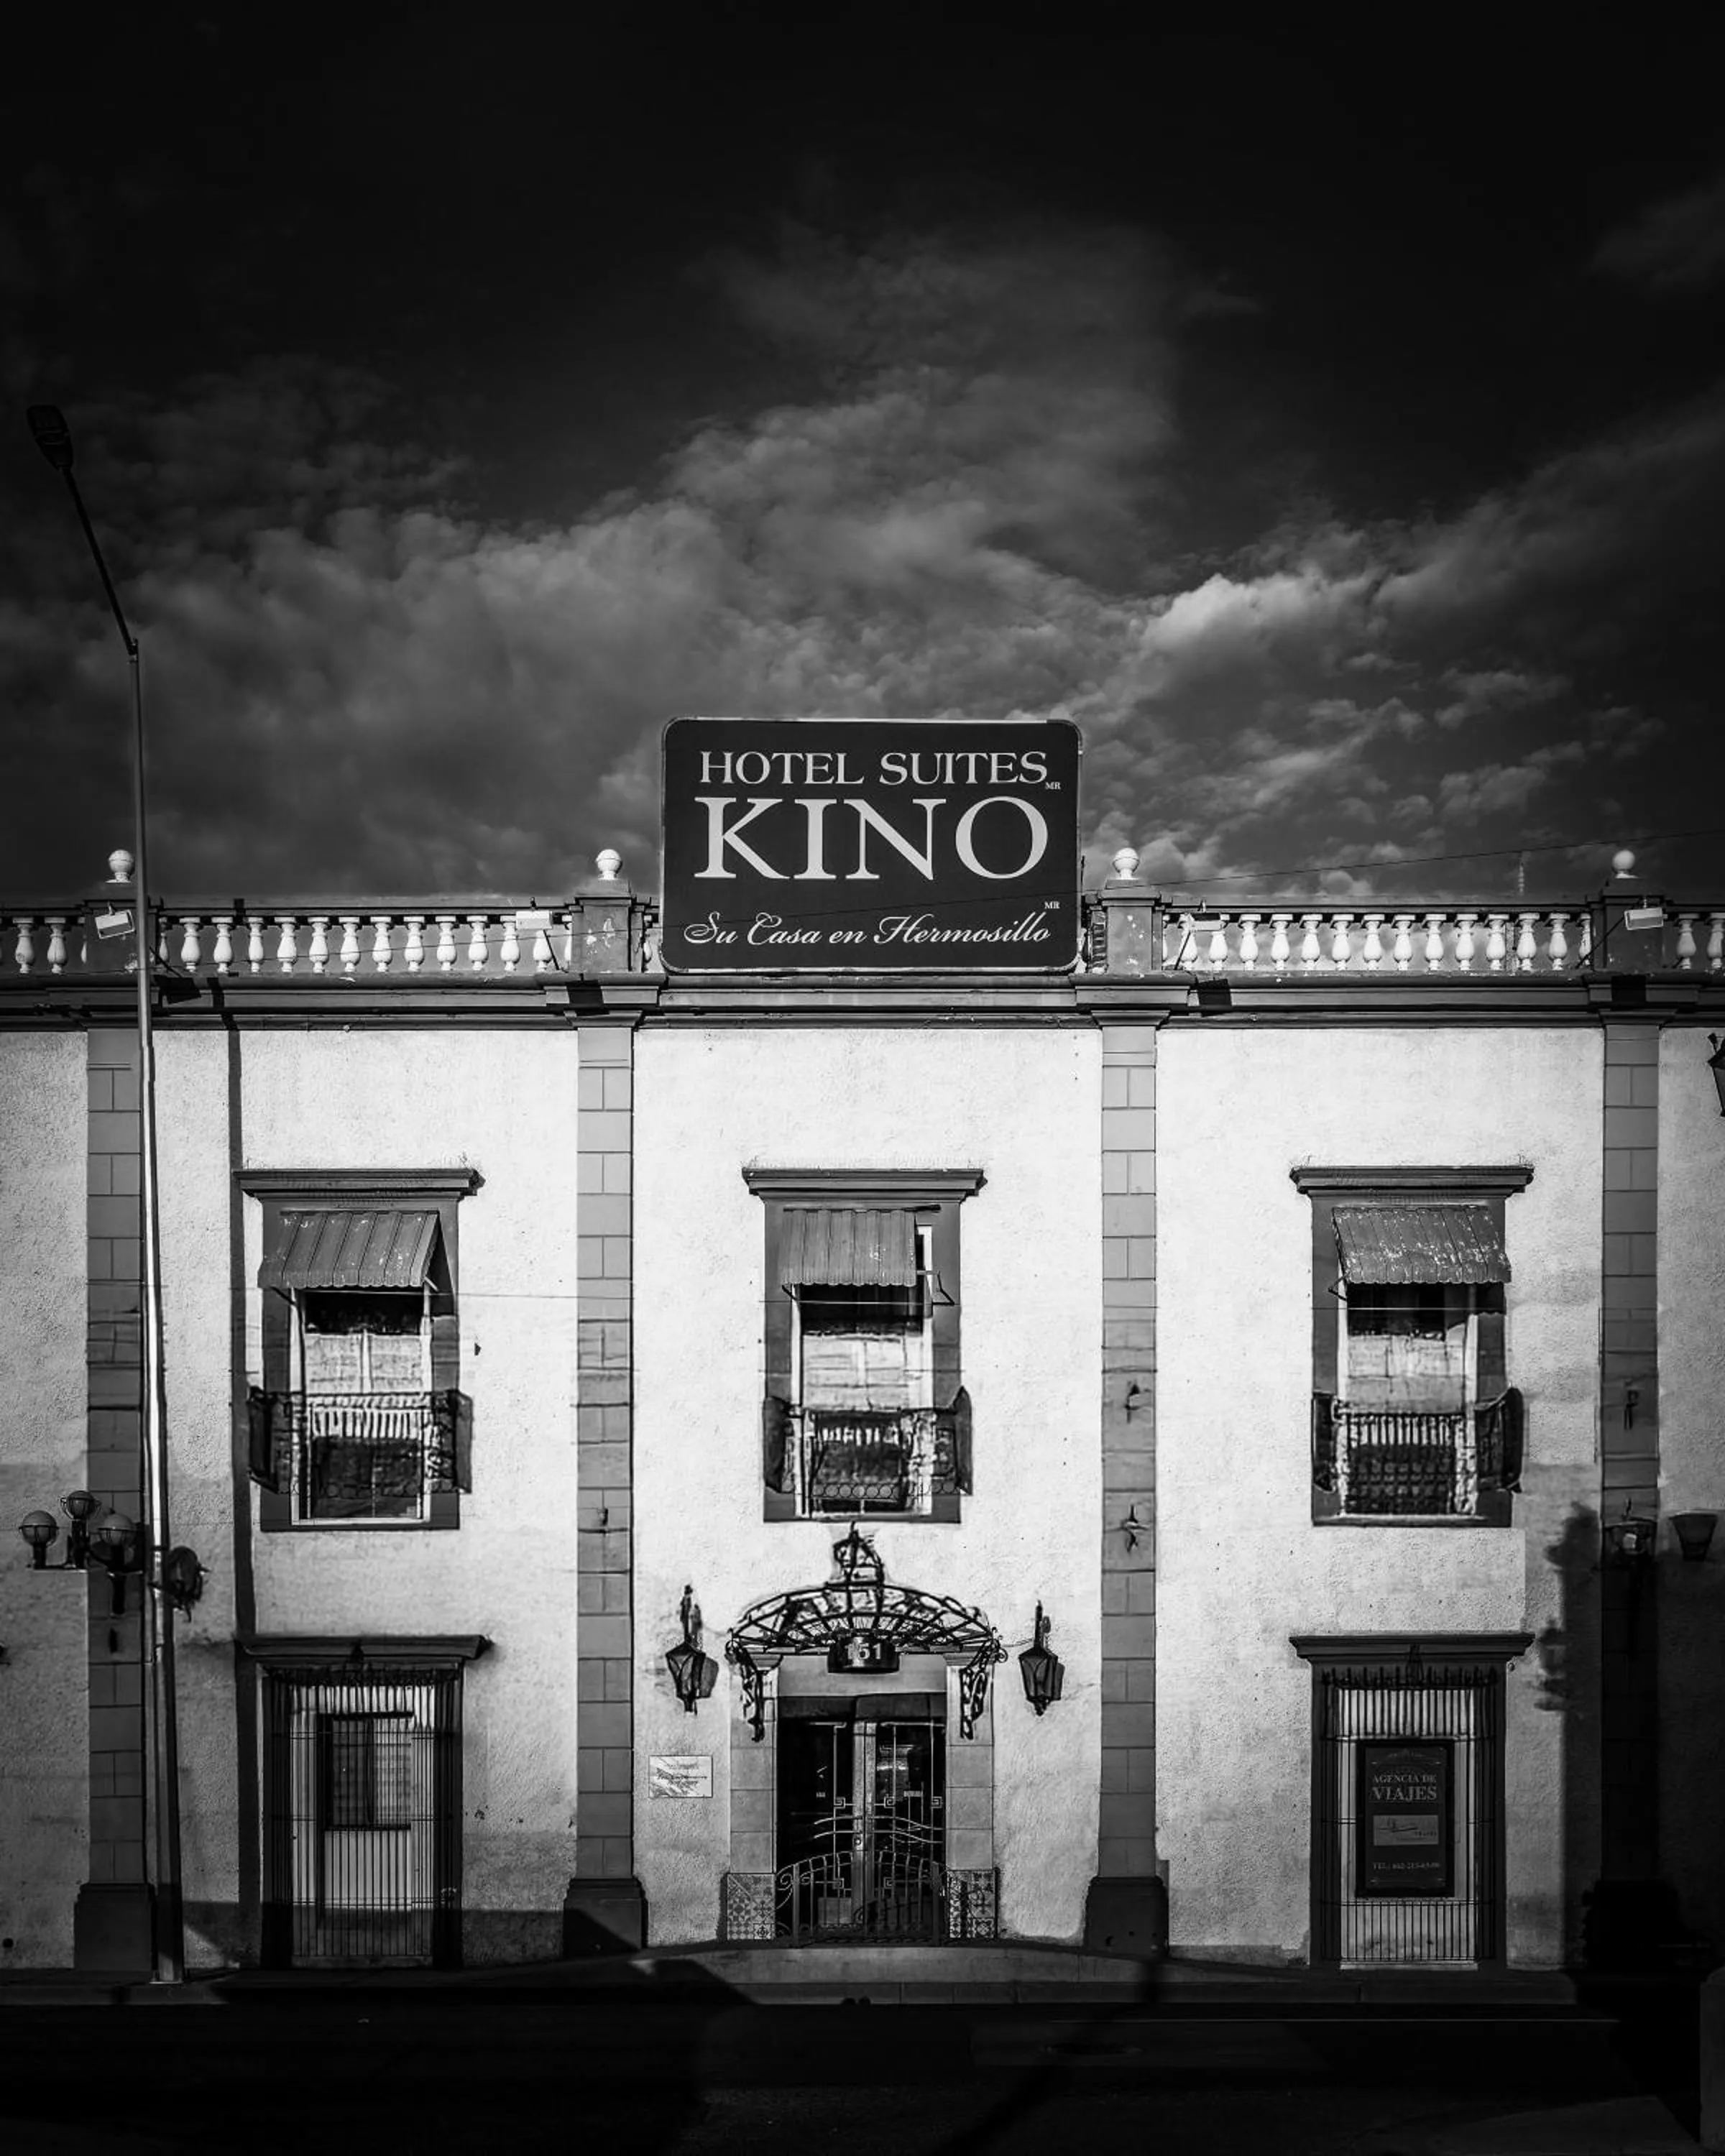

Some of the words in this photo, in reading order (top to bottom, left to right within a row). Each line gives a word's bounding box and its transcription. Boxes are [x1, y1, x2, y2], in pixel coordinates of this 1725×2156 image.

[700, 751, 865, 784] HOTEL
[879, 751, 1048, 785] SUITES
[1044, 781, 1062, 790] MR
[694, 796, 1049, 880] KINO
[1044, 900, 1060, 910] MR
[684, 911, 739, 944] Su
[747, 911, 823, 946] Casa
[828, 930, 869, 944] en
[873, 911, 1052, 945] Hermosillo
[844, 1643, 881, 1659] 151
[1374, 1774, 1420, 1783] AGENCIA
[1422, 1774, 1438, 1783] DE
[1371, 1786, 1438, 1802] VIAJES
